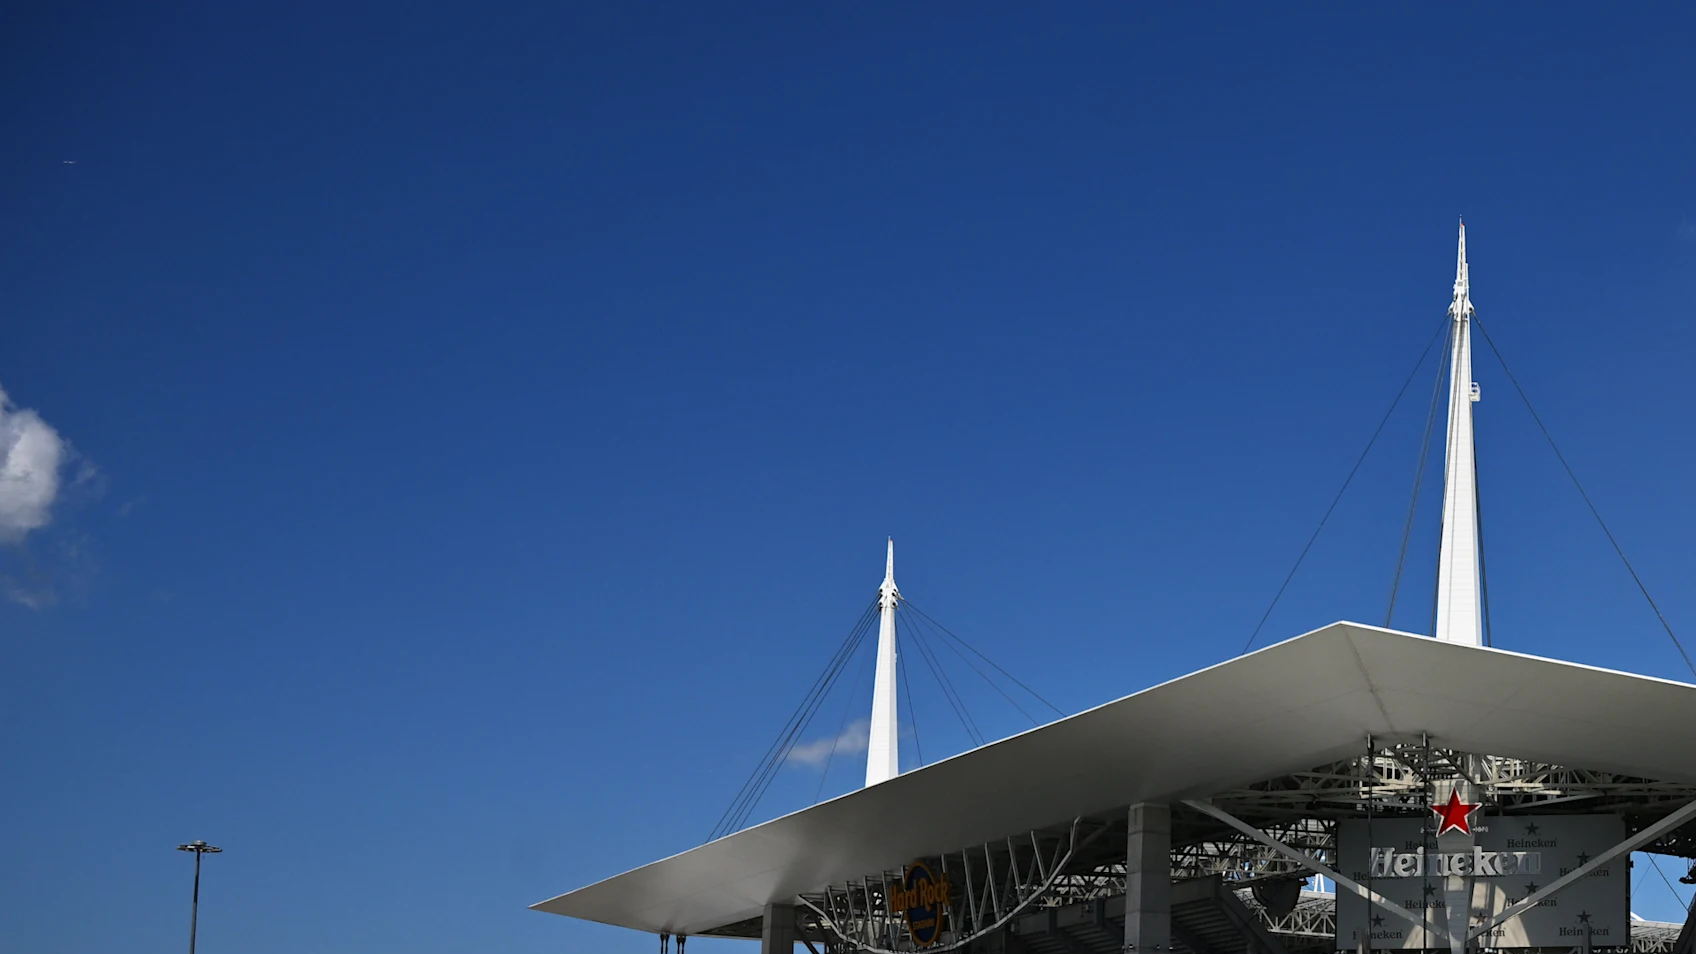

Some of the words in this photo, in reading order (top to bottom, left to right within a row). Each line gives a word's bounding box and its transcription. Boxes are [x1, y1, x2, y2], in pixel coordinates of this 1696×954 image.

[1507, 839, 1557, 848] Heineken
[1371, 846, 1541, 877] Heineken
[888, 879, 919, 913] Hard
[918, 872, 952, 913] Rock
[1559, 927, 1609, 936] Heinken
